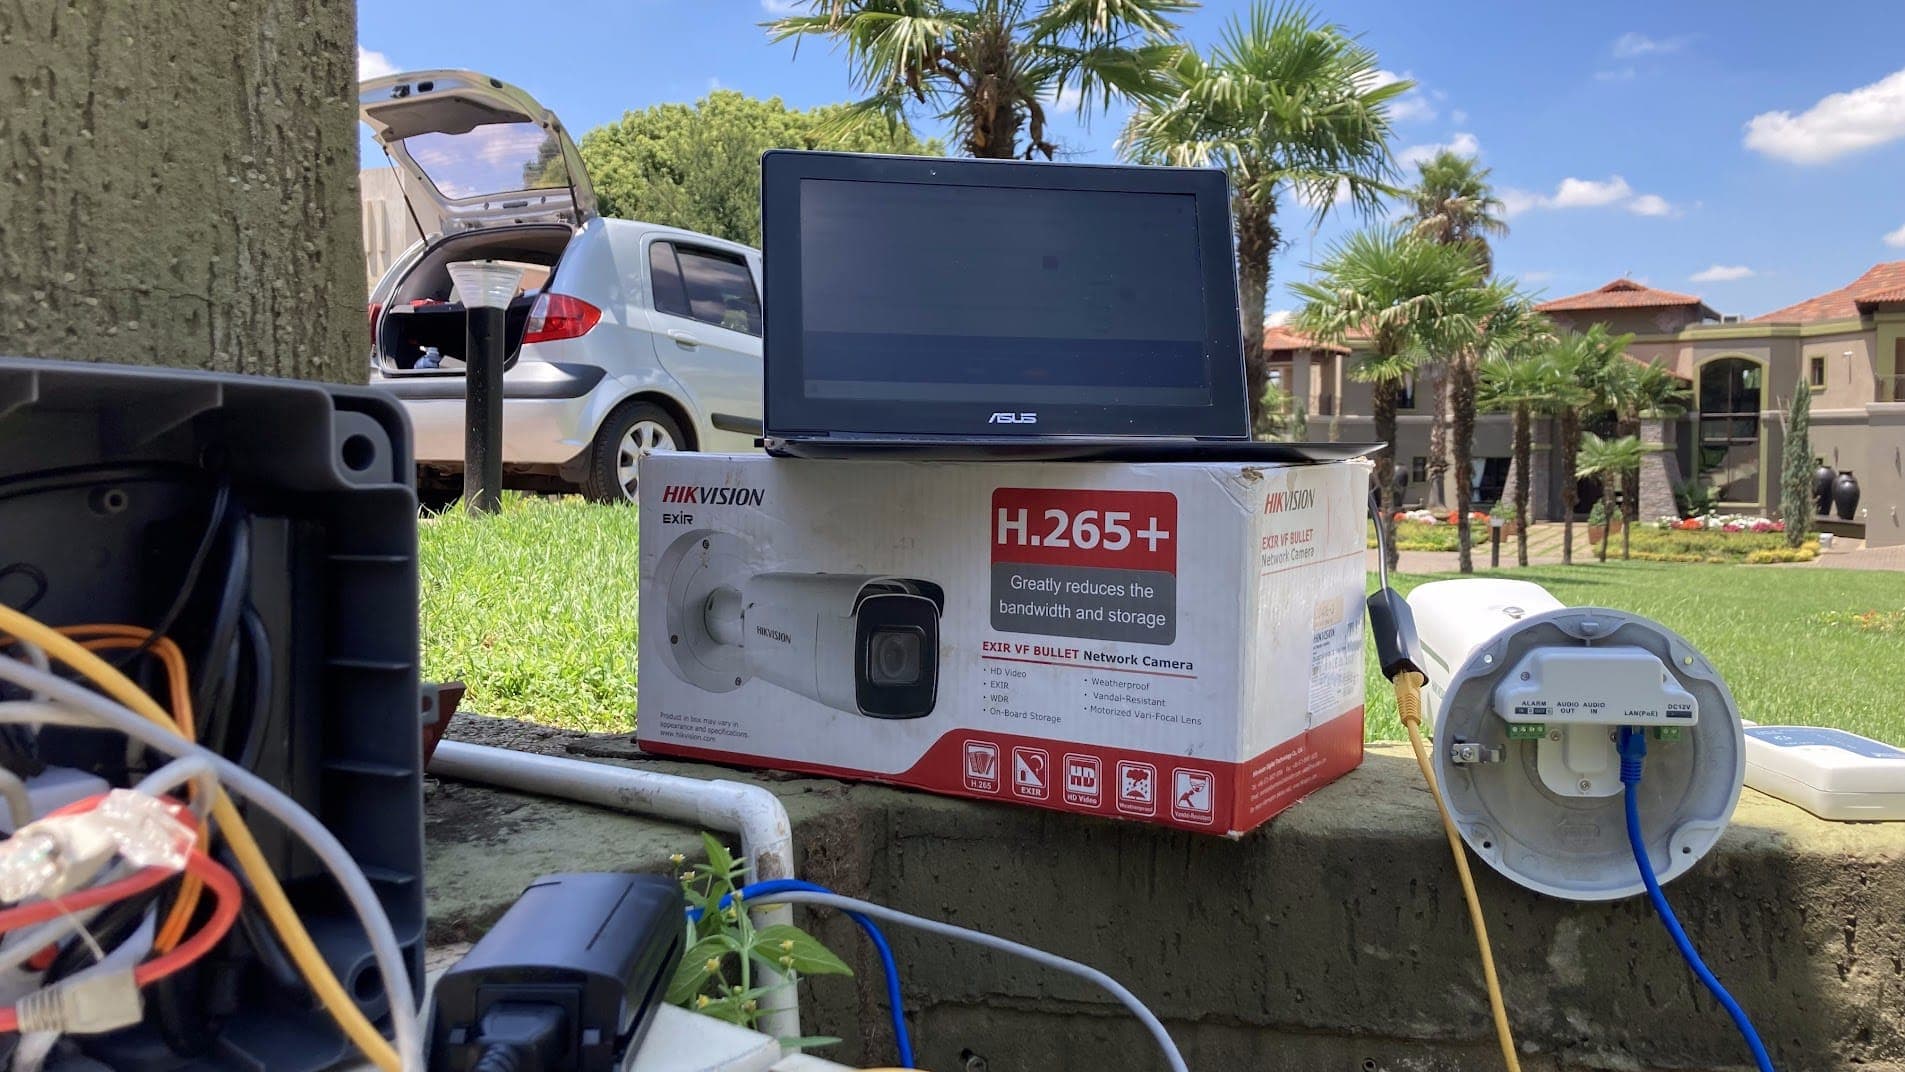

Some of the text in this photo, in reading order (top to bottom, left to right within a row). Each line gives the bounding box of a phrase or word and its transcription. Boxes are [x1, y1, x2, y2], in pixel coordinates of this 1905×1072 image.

[988, 412, 1037, 424] ASUS
[662, 485, 765, 506] HIKVISION
[1264, 488, 1316, 515] HIKVISION
[997, 507, 1169, 552] H.265+
[1262, 528, 1314, 550] EXIR VF BULLET
[1262, 546, 1315, 567] Network Camera
[1011, 575, 1154, 598] Greatly reduces the
[999, 600, 1166, 629] bandwidth and storage
[756, 625, 792, 644] HIKVISION
[982, 641, 1194, 670] EXIR VF BULLET Network Camera
[990, 667, 1027, 678] HD Video
[990, 680, 1009, 689] EXIR
[1091, 678, 1150, 691] Weatherproof
[990, 694, 1009, 703] WDR
[1093, 692, 1166, 707] Vandal-Resistant
[990, 707, 1062, 724] On-Board Storage
[1090, 705, 1202, 726] Motorized Vari-Focal Lens
[1021, 786, 1041, 796] EXIR
[1079, 795, 1098, 805] Video
